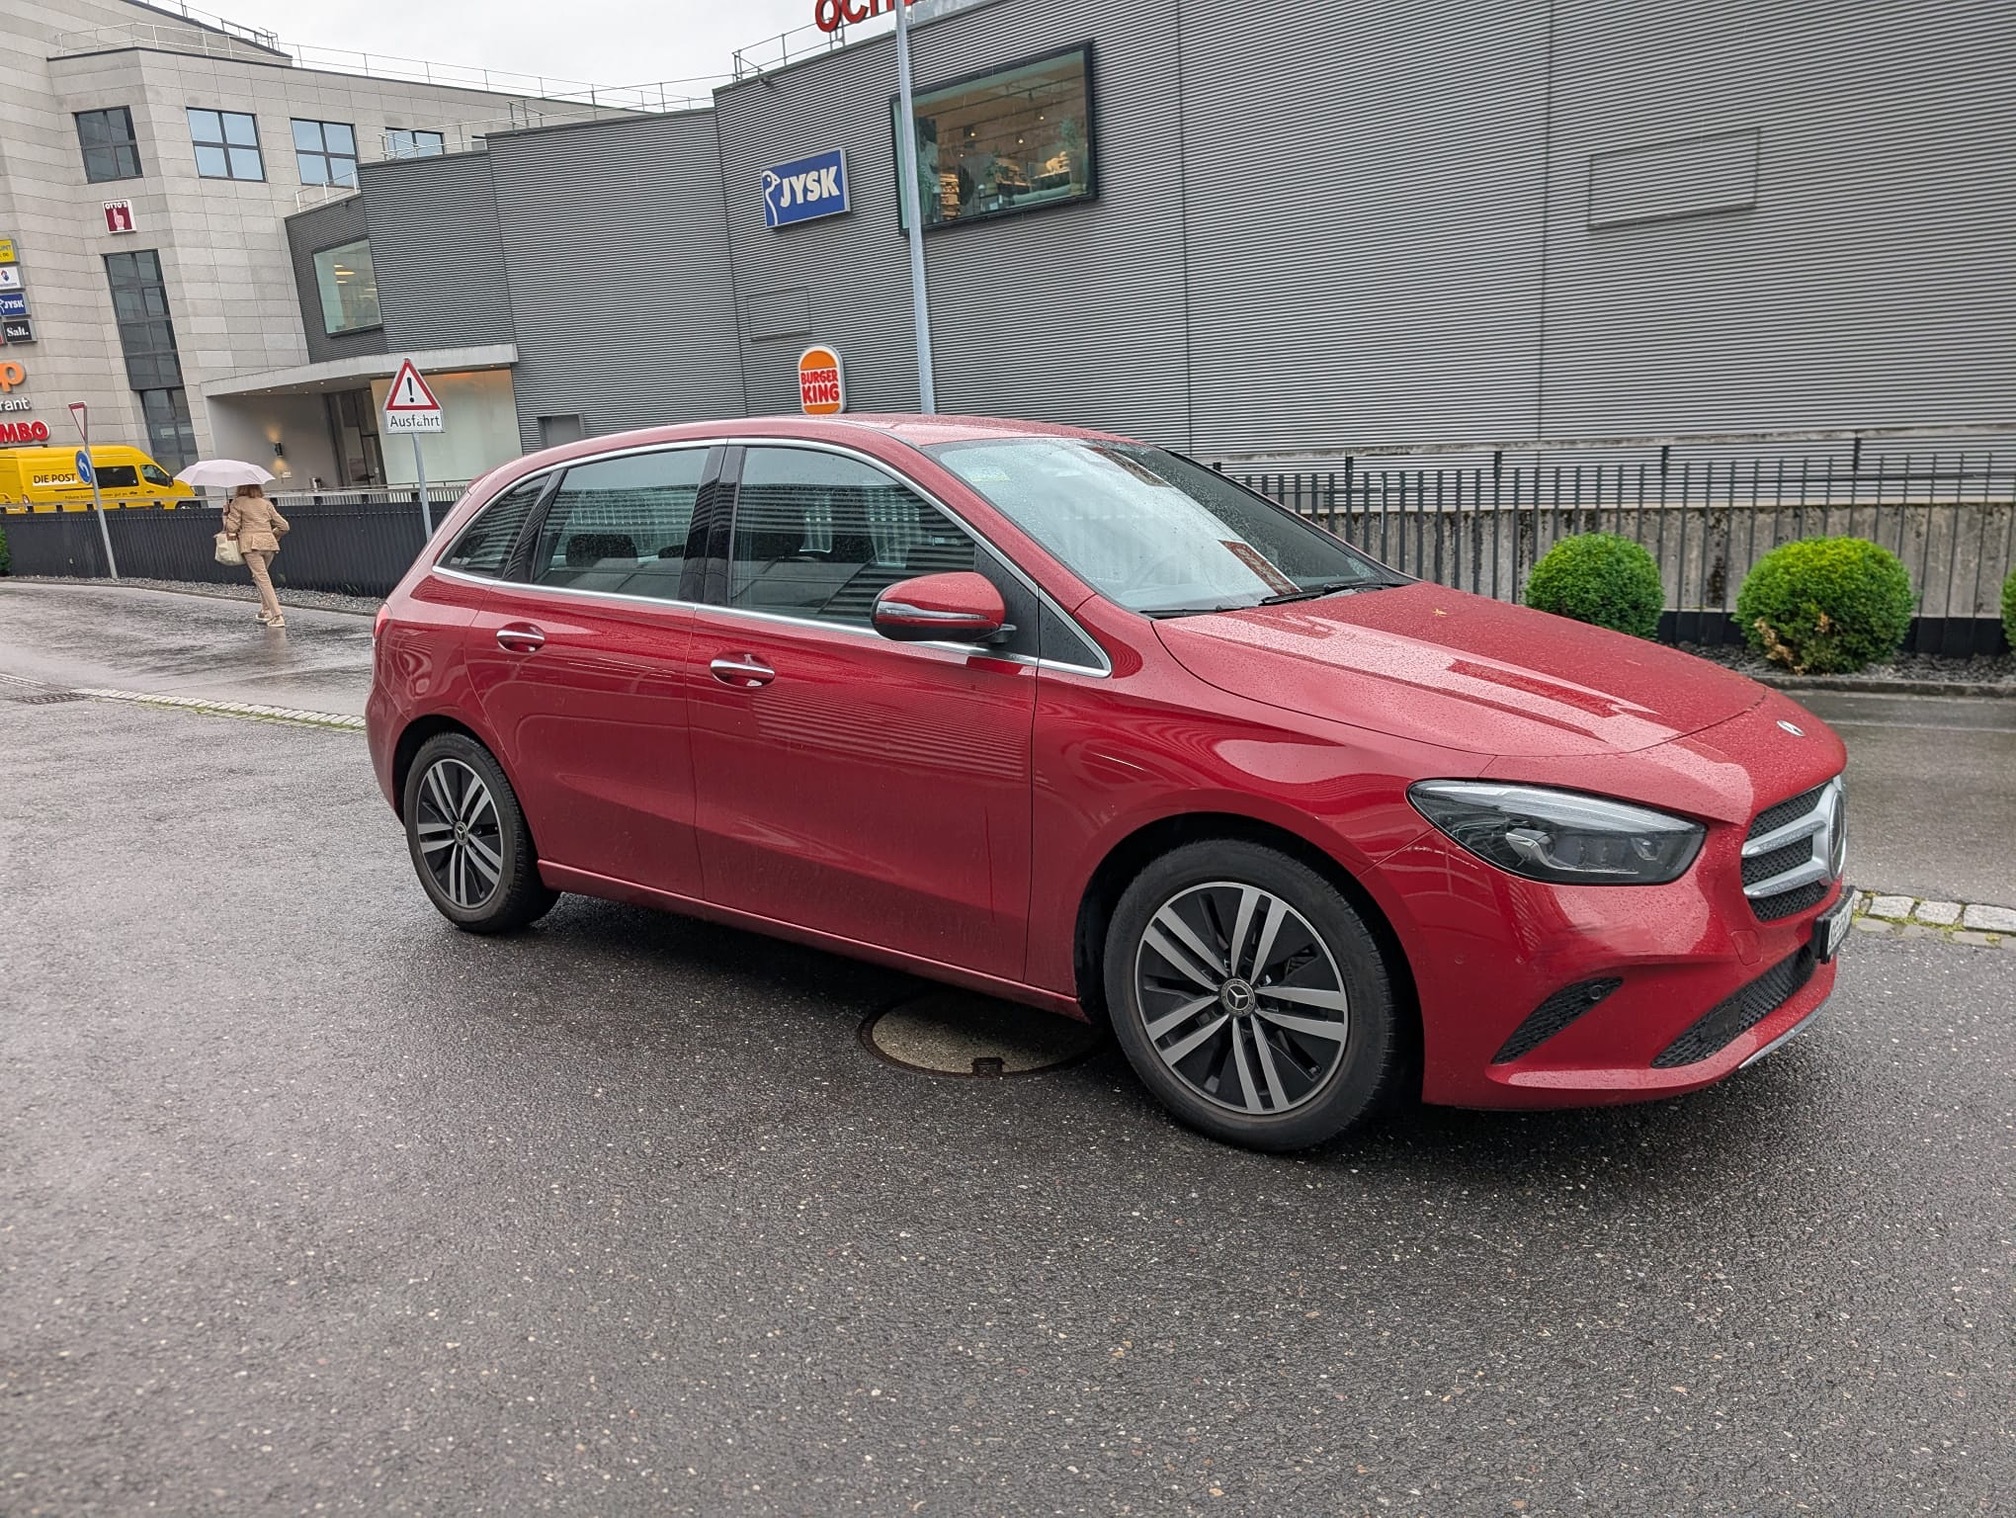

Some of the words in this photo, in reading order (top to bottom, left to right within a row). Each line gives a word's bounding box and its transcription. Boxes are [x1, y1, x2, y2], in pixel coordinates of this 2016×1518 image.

[780, 165, 841, 208] JYSK
[4, 299, 25, 309] JYSK
[6, 326, 29, 337] Salt.
[800, 369, 839, 385] BURGER
[802, 383, 840, 404] KING
[390, 414, 440, 428] Ausfahrt
[33, 474, 50, 484] DIE
[51, 473, 76, 482] POST
